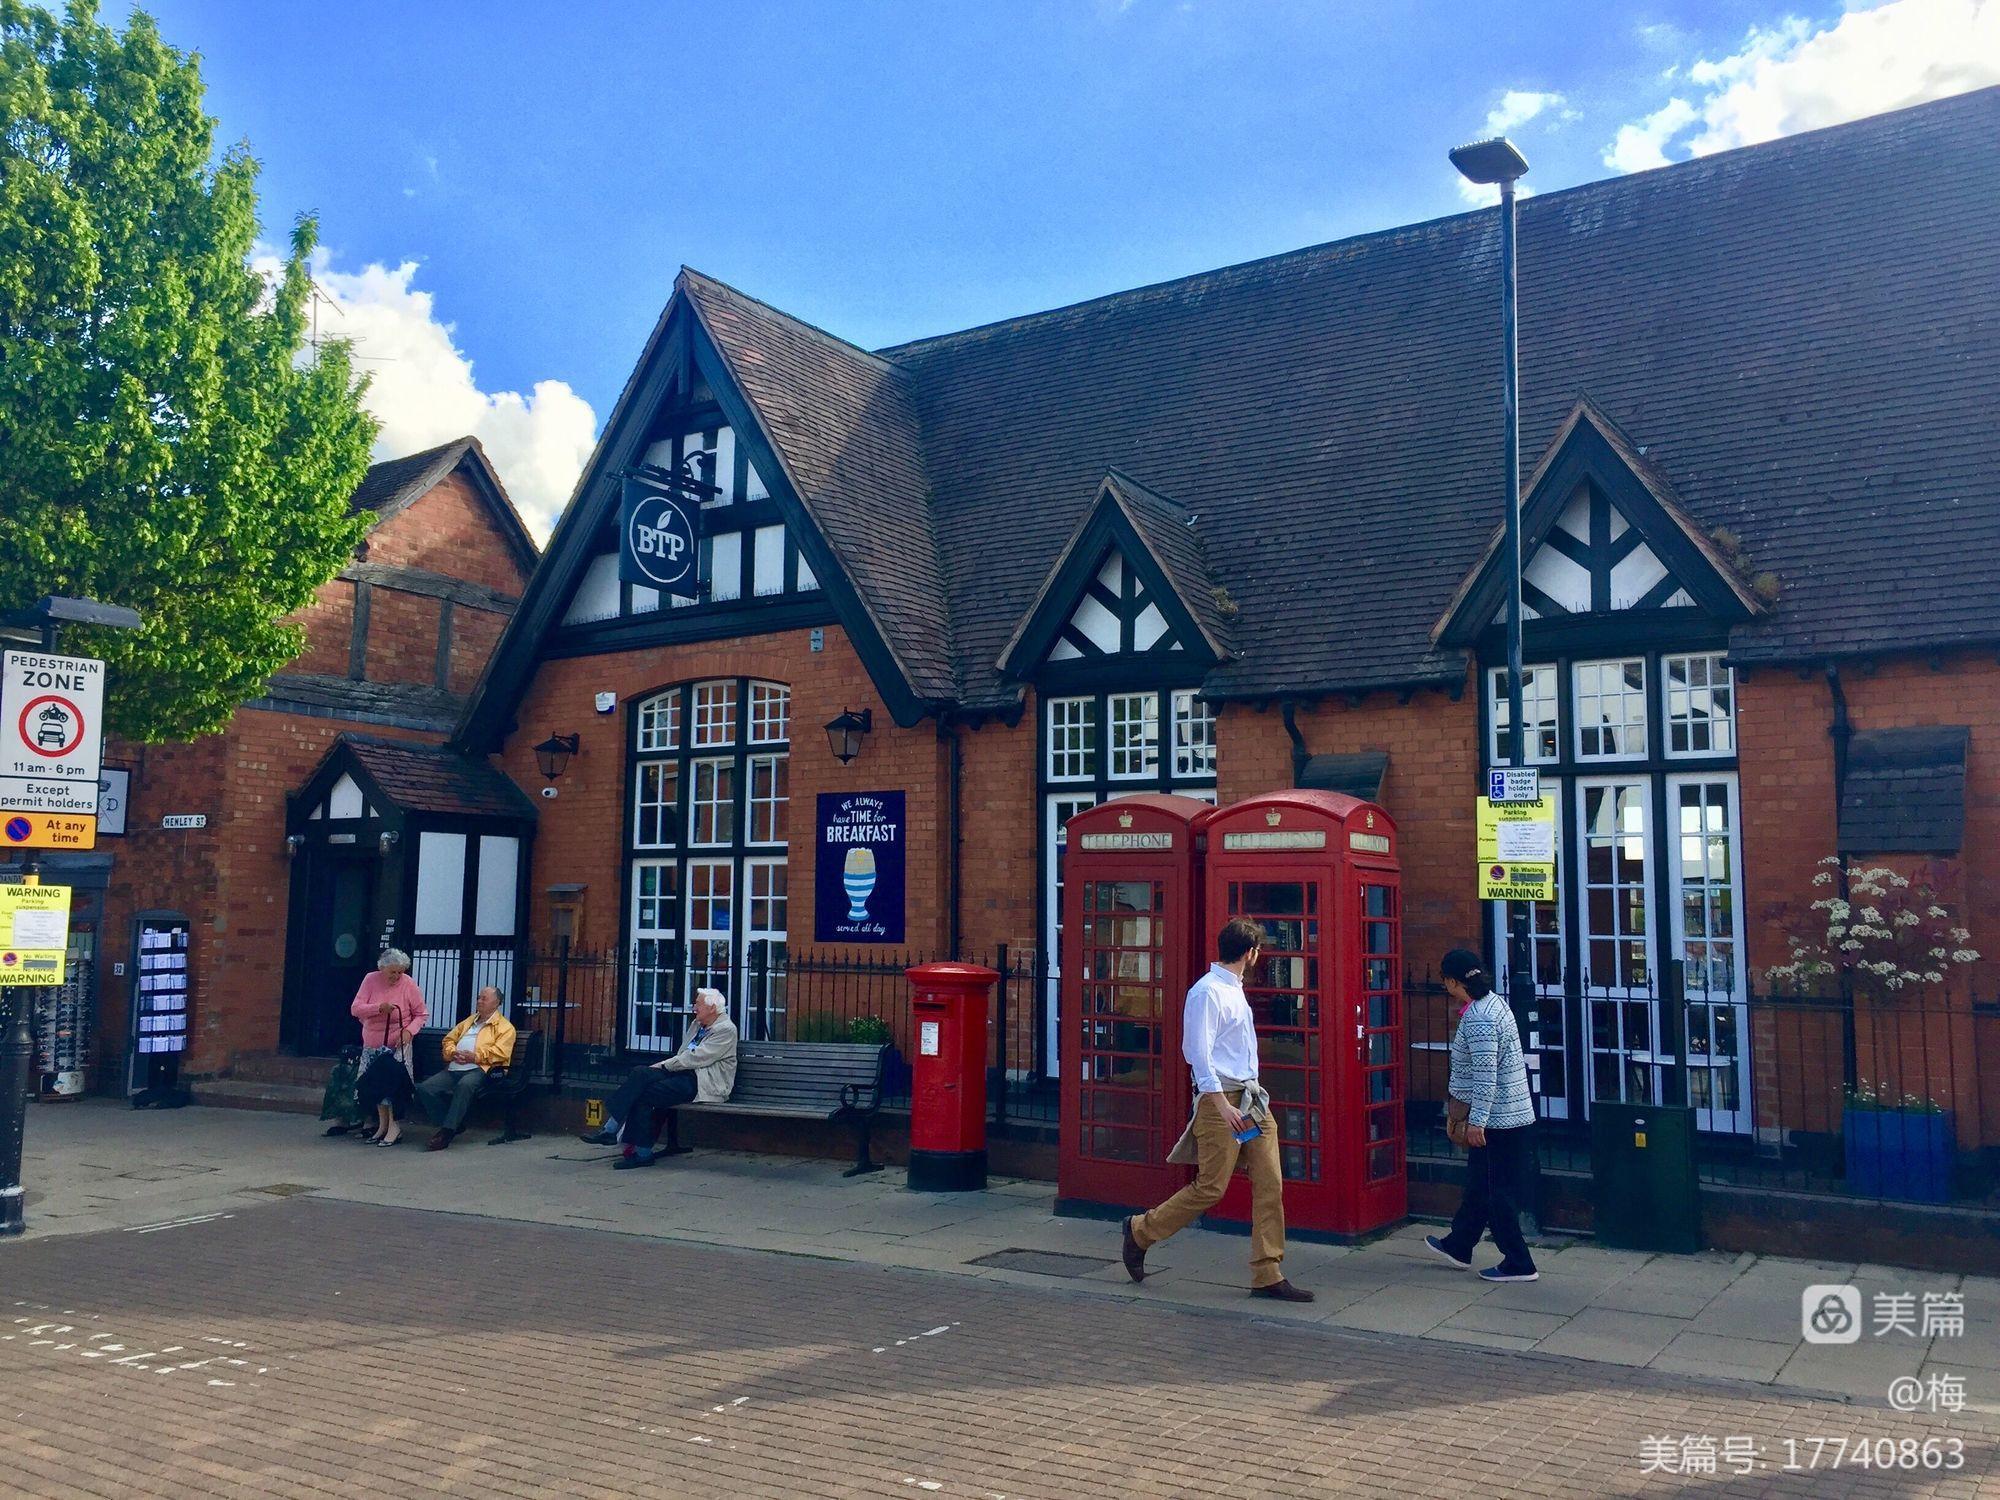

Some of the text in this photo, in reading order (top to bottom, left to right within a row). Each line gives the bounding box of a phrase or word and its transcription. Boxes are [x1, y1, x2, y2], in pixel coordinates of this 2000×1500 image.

[637, 524, 685, 561] BTP
[11, 655, 98, 673] PEDESTRIAN
[23, 671, 85, 691] ZONE
[26, 783, 70, 796] Except
[1, 796, 93, 809] permit holders
[841, 797, 883, 811] WE ALWAYS
[165, 817, 193, 827] HENLEY
[833, 810, 887, 823] have TIME for
[46, 819, 86, 832] At any
[52, 832, 79, 843] time
[826, 824, 897, 843] BREAKFAST
[1087, 834, 1170, 848] TELEPHONE
[7, 887, 61, 898] WARNING
[1487, 888, 1545, 898] WARNING
[836, 922, 886, 936] served all day
[0, 974, 56, 983] WARNING
